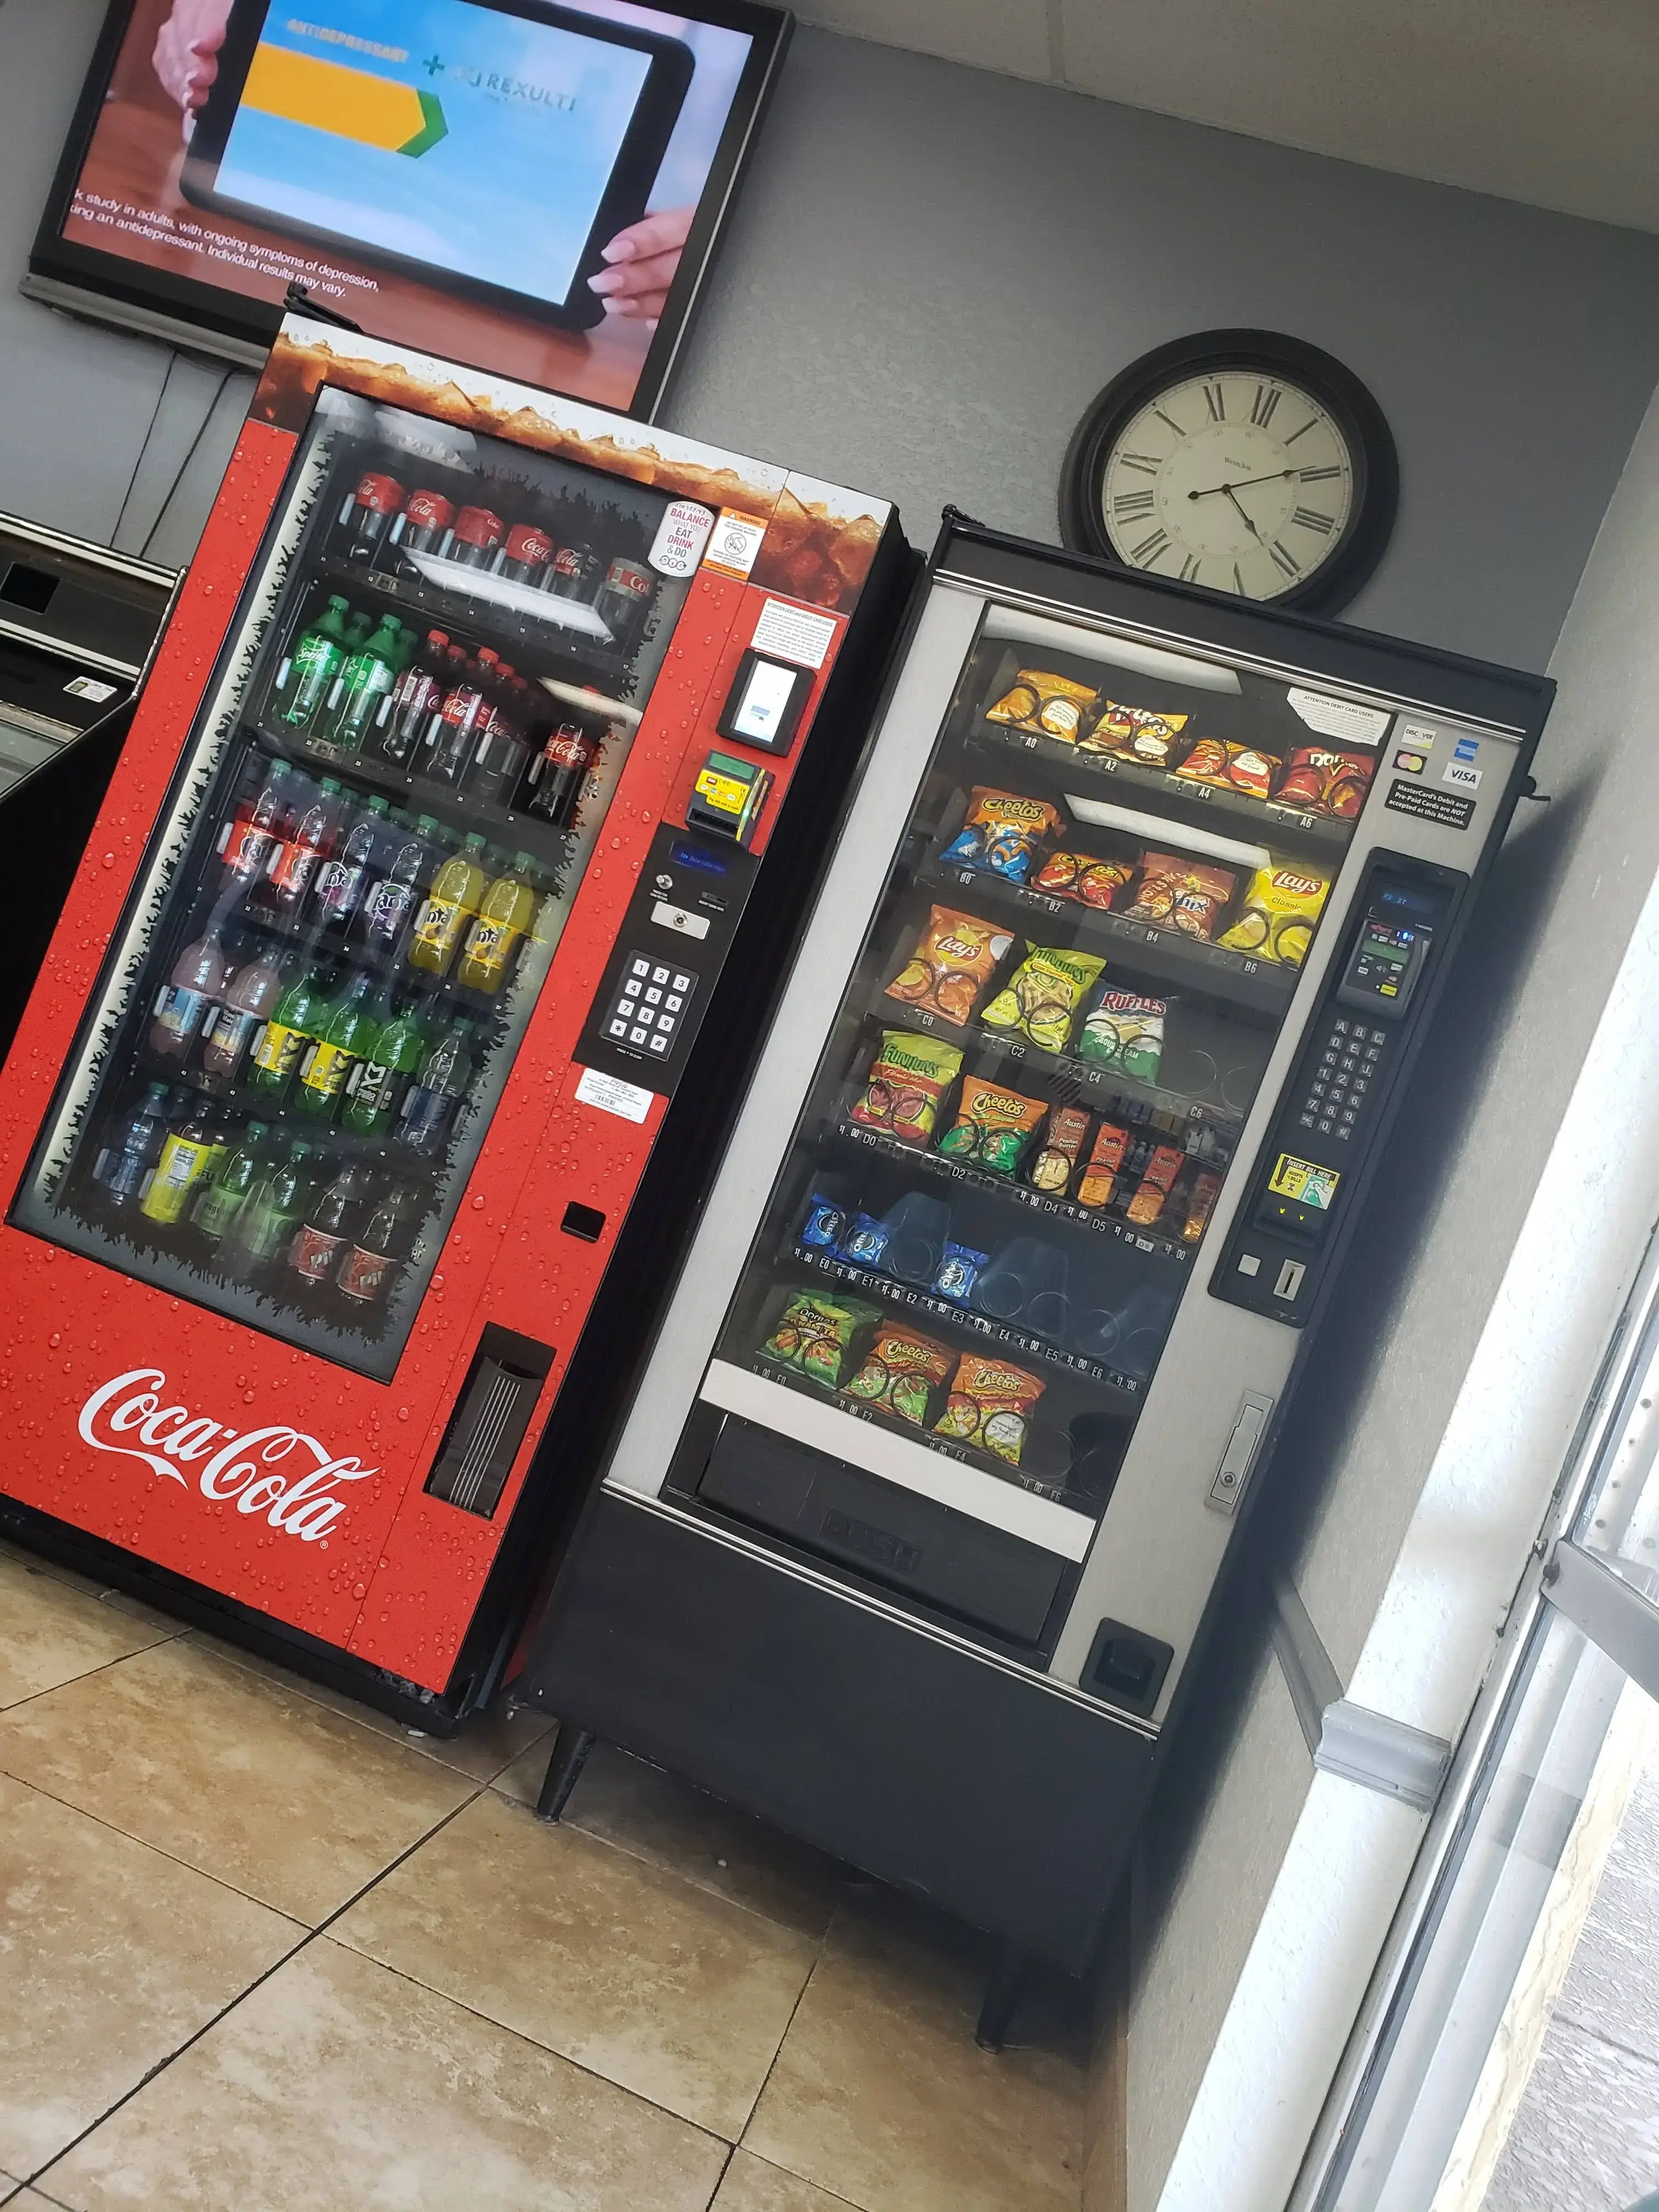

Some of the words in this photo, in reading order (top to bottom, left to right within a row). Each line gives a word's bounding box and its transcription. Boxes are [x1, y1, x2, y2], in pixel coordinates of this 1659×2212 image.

[486, 73, 577, 111] REXULTI
[86, 194, 121, 213] study
[124, 205, 134, 216] in
[137, 209, 176, 230] adults,
[179, 222, 202, 236] with
[204, 230, 247, 252] ongoing
[249, 244, 304, 269] symptoms
[306, 259, 318, 271] of
[318, 264, 380, 292] depression,
[97, 212, 114, 224] an
[116, 219, 204, 253] antidepressant.
[207, 245, 258, 269] Individual
[258, 259, 295, 280] results
[295, 274, 320, 290] may
[321, 281, 347, 297] vary.
[669, 507, 710, 528] BALANCE
[673, 518, 689, 528] WHAT
[689, 523, 702, 533] YOU
[675, 527, 693, 539] EAT
[667, 534, 696, 550] DRINK
[674, 545, 687, 557] DO
[1304, 695, 1330, 707] ATTENTION
[1330, 702, 1344, 710] DEBIT
[1358, 710, 1374, 718] USERS
[1025, 737, 1037, 748] A0
[1104, 761, 1117, 772] A2
[1451, 770, 1476, 783] VISA
[1198, 788, 1210, 799] A4
[1397, 784, 1437, 800] MasterCard's
[1437, 795, 1455, 806] Debit
[1455, 799, 1468, 809] and
[983, 799, 1045, 821] Cheetos
[1395, 792, 1421, 806] Pre-Paid
[1421, 799, 1439, 811] Cards
[1451, 808, 1465, 817] NOT
[1389, 799, 1417, 812] accepted
[1424, 808, 1437, 817] this
[1437, 811, 1465, 826] Machine.
[1300, 816, 1313, 828] A6
[960, 873, 971, 884] B0
[1272, 871, 1321, 894] Lay's
[1048, 901, 1061, 913] B2
[1146, 931, 1159, 943] B4
[935, 935, 982, 959] Lay's
[1244, 961, 1257, 973] B6
[1101, 991, 1168, 1016] RUFFLES
[922, 1015, 933, 1026] C0
[1356, 1028, 1363, 1036] B
[1374, 1034, 1381, 1042] C
[1011, 1046, 1024, 1058] C2
[1350, 1043, 1358, 1052] E
[1327, 1054, 1334, 1062] G
[1345, 1059, 1352, 1068] H
[1089, 1072, 1101, 1084] C4
[1323, 1069, 1327, 1077] 1
[1339, 1075, 1346, 1083] 2
[1333, 1090, 1340, 1098] 5
[1352, 1097, 1358, 1105] 6
[970, 1092, 1027, 1118] Cheetos
[1190, 1106, 1203, 1118] C6
[1328, 1106, 1334, 1114] 8
[1346, 1112, 1352, 1120] 9
[1063, 1117, 1086, 1131] Austin
[1322, 1122, 1328, 1130] 0
[1059, 1138, 1079, 1147] Peanut
[1101, 1137, 1124, 1150] Austin
[1155, 1156, 1177, 1170] Austin
[1287, 1159, 1305, 1170] INSERT
[1317, 1171, 1331, 1179] HERE
[839, 1125, 859, 1139] $1.00
[862, 1135, 876, 1147] D0
[951, 1168, 966, 1180] D2
[1019, 1191, 1039, 1207] $1.00
[1045, 1201, 1057, 1214] D4
[1092, 1219, 1107, 1232] D5
[794, 1248, 813, 1263] $1.00
[819, 1257, 829, 1269] E0
[837, 1267, 857, 1281] $1.00
[862, 1276, 874, 1288] E1
[882, 1284, 900, 1299] $1.00
[906, 1293, 917, 1305] E2
[952, 1312, 964, 1324] E3
[974, 1319, 992, 1334] $1.00
[999, 1329, 1009, 1341] E4
[1018, 1338, 1040, 1351] $1.00
[1045, 1348, 1059, 1361] E5
[1067, 1356, 1087, 1369] $1.00
[1091, 1367, 1103, 1379] E6
[1116, 1376, 1137, 1391] $1.00
[799, 1307, 837, 1325] Doritos
[885, 1340, 932, 1364] Cheetos
[973, 1369, 1022, 1392] Cheetos
[78, 1368, 382, 1543] Coca-Cola
